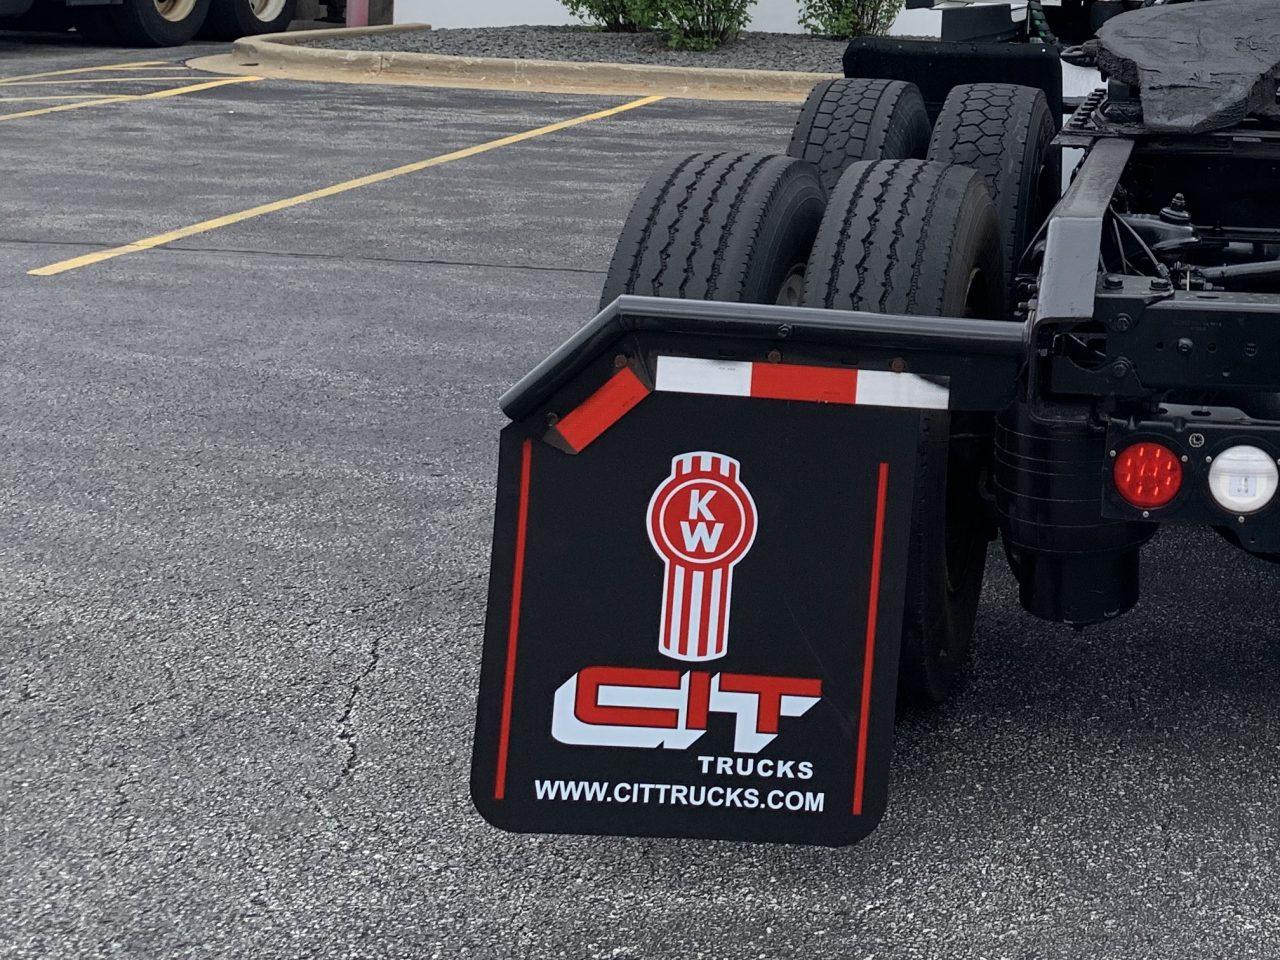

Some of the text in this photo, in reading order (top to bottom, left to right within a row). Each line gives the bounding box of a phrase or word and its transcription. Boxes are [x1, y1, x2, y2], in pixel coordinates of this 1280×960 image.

[551, 666, 822, 753] CIT
[697, 756, 814, 780] TRUCKS
[534, 779, 825, 812] WWW.CITTRUCKS.COM
